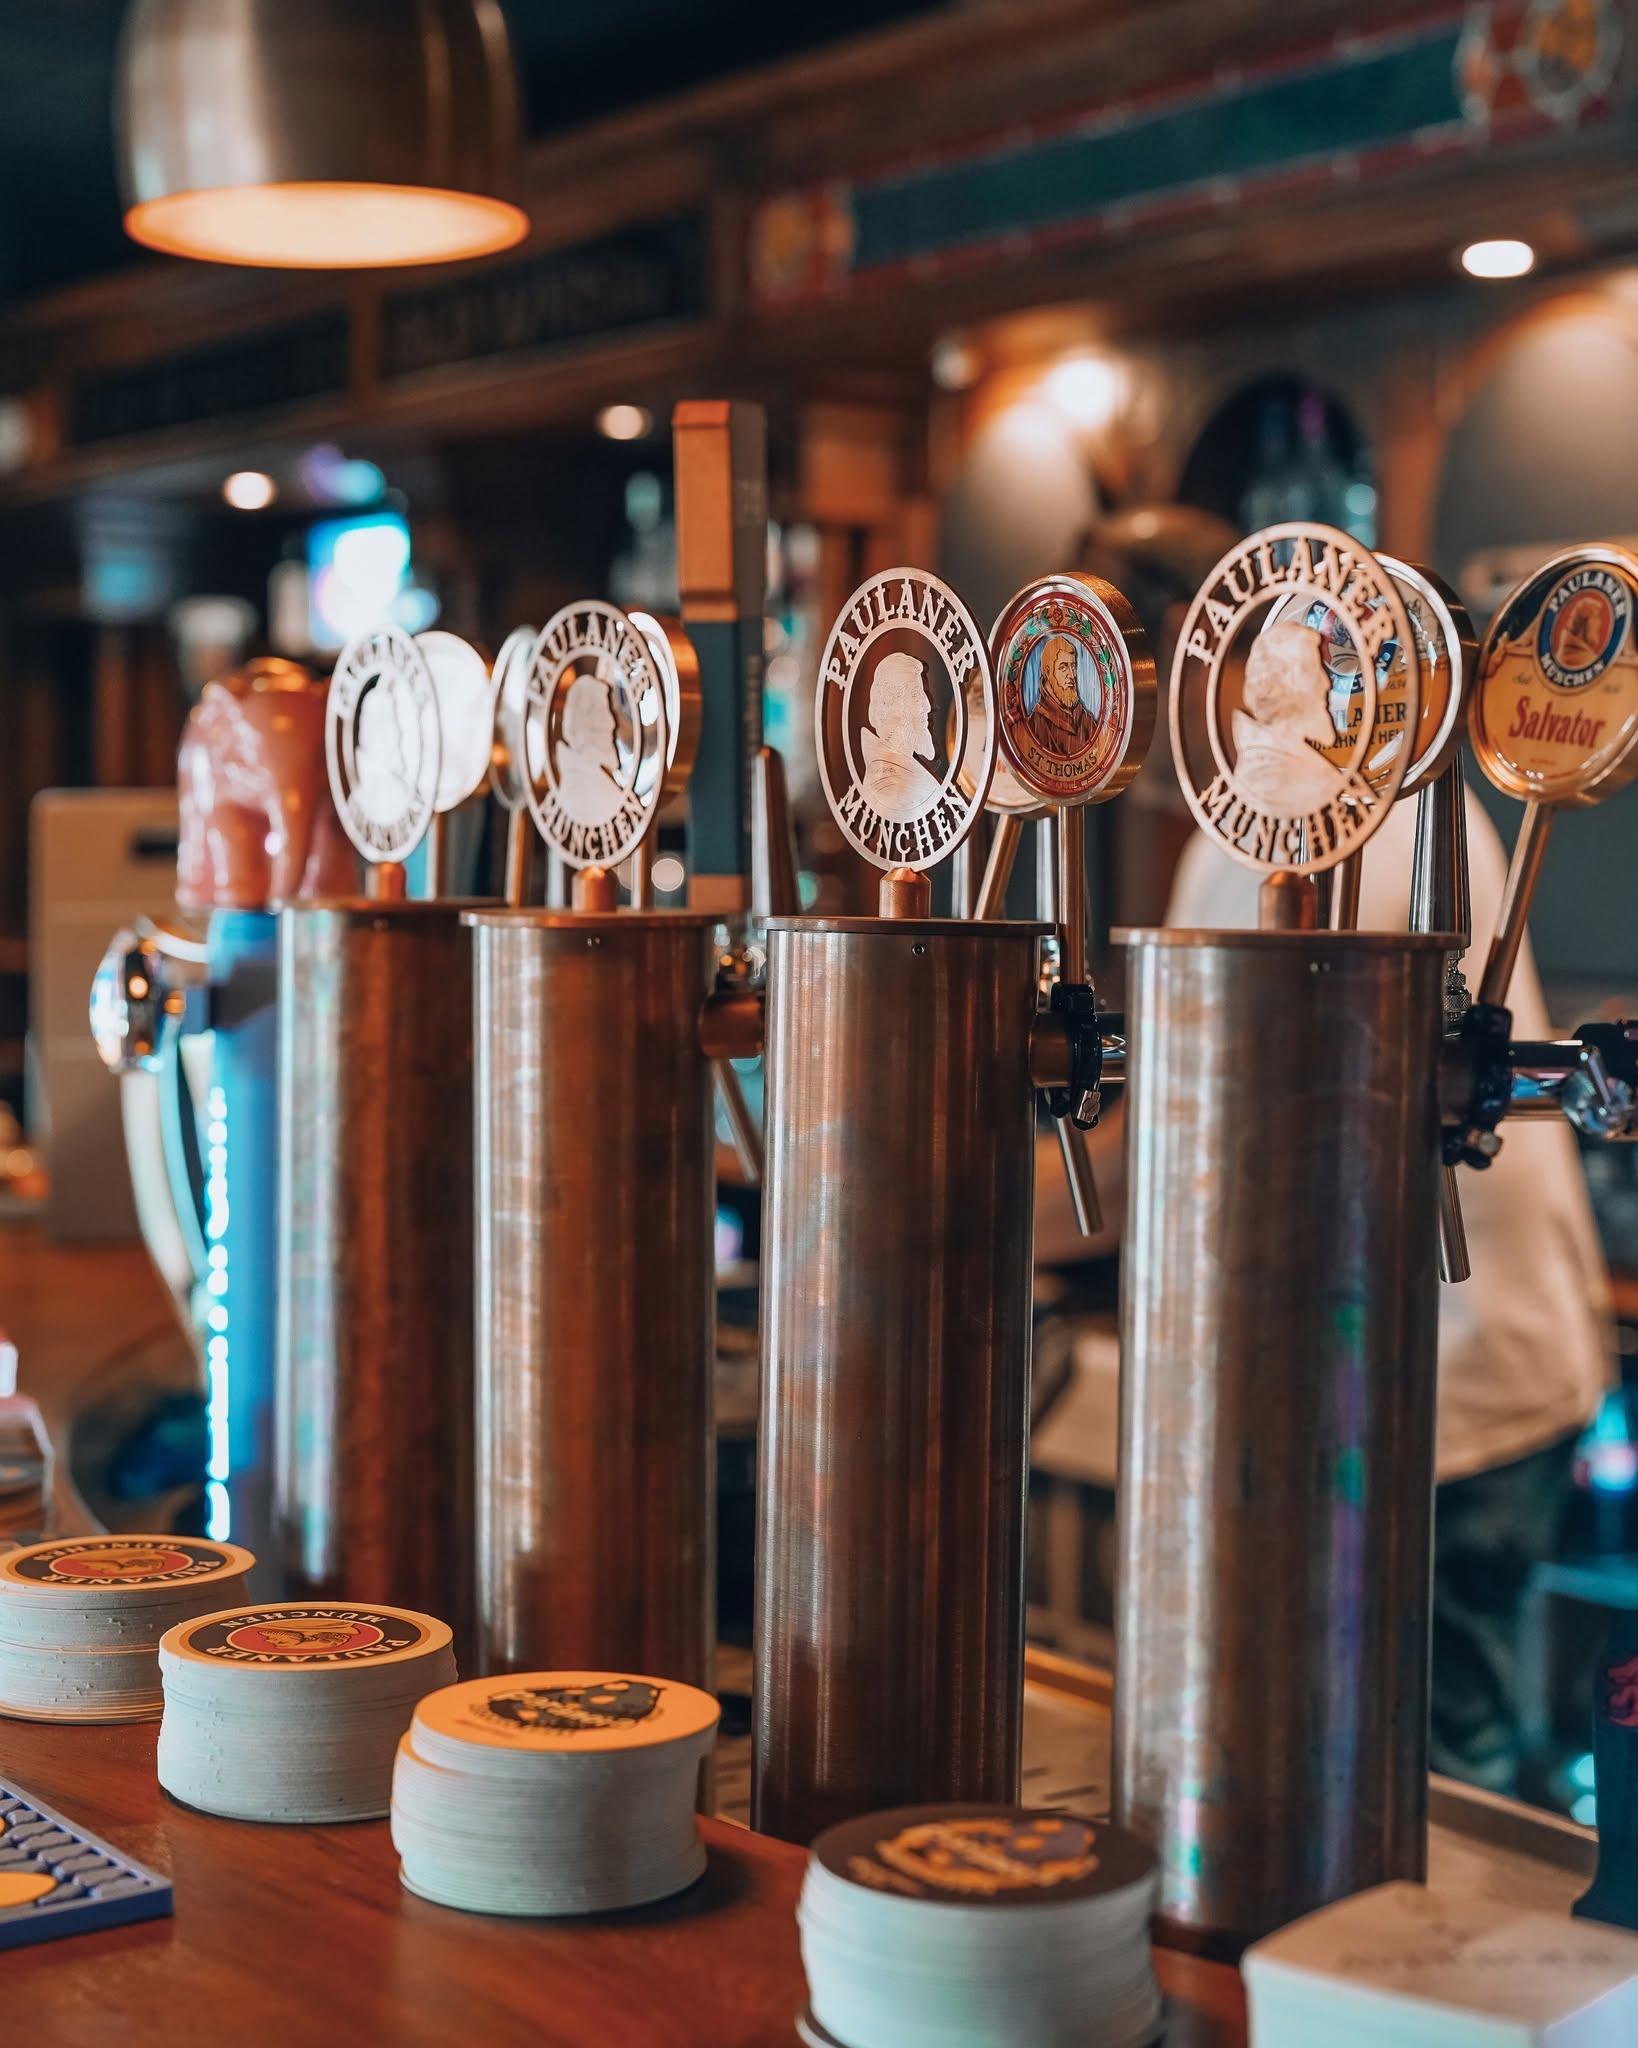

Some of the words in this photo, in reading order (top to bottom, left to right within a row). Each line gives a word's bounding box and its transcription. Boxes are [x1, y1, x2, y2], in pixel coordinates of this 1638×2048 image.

[1187, 537, 1396, 666] PAULANER
[527, 611, 652, 706] PAULANER
[826, 580, 977, 690] PAULANER
[1508, 695, 1606, 749] Salvator
[1028, 747, 1044, 769] ST.
[1046, 752, 1097, 778] THOMAS
[40, 1560, 221, 1585] PAULANER
[206, 1638, 411, 1663] PAULANER
